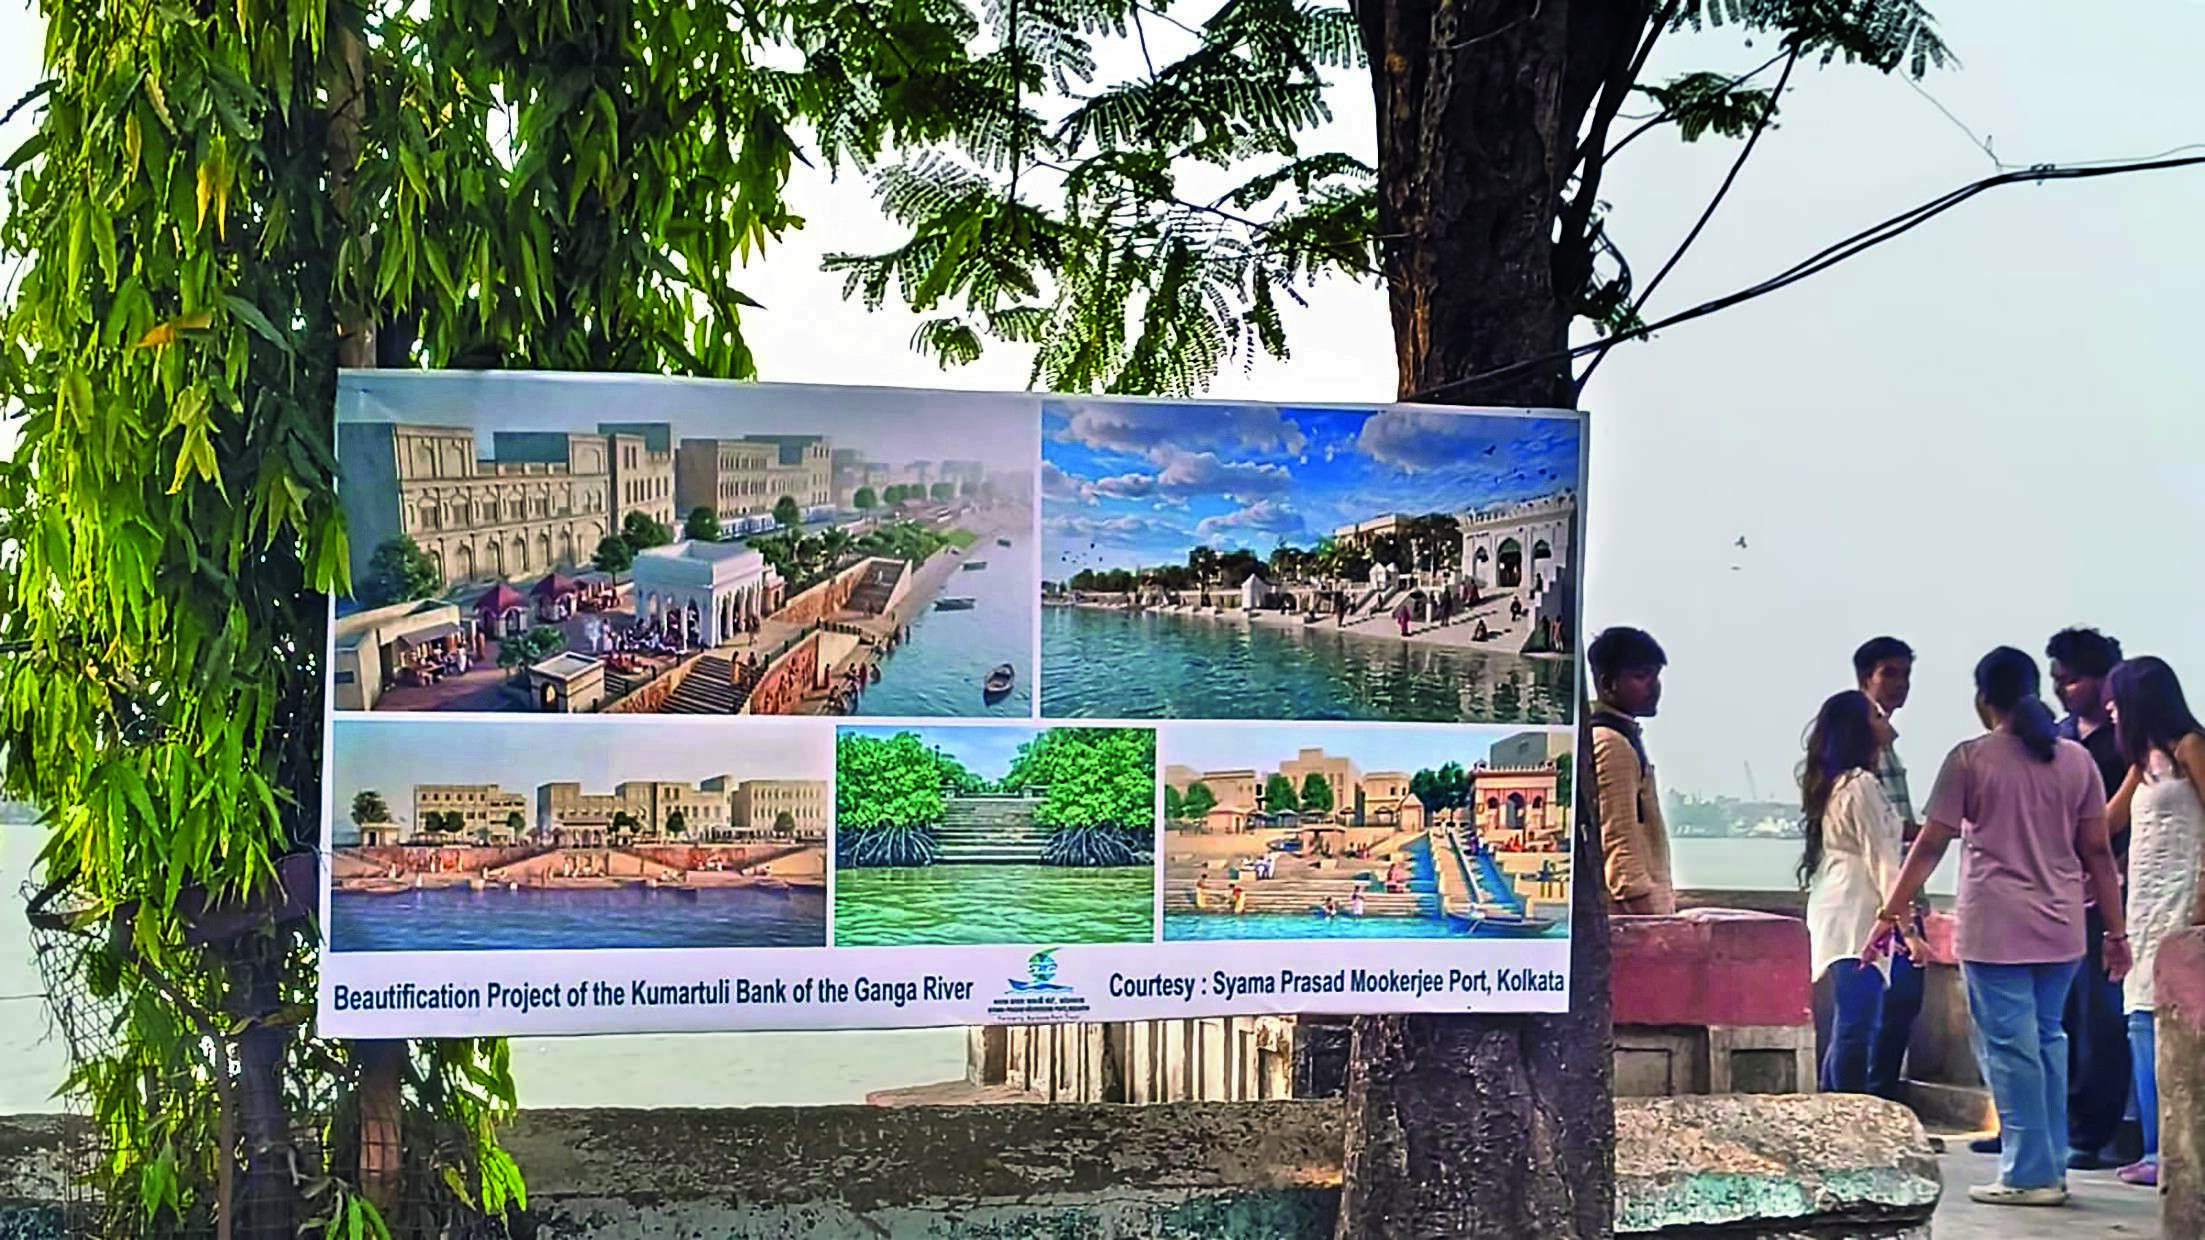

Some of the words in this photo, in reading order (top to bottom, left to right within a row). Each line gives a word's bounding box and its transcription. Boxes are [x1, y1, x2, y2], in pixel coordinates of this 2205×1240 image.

[335, 983, 480, 1010] Beautification
[488, 982, 560, 1013] Project
[567, 981, 588, 1007] of
[593, 981, 625, 1006] the
[632, 979, 729, 1005] Kumartuli
[737, 979, 786, 1003] Bank
[793, 978, 813, 1003] of
[819, 978, 848, 1003] the
[855, 977, 917, 1007] Ganga
[924, 976, 973, 1000] River
[1110, 973, 1195, 1002] Courtesy
[1213, 971, 1275, 1000] Syama
[1281, 970, 1344, 993] Prasad
[1351, 969, 1443, 997] Mookerjee
[1450, 970, 1491, 995] Port,
[1498, 969, 1563, 991] Kolkata
